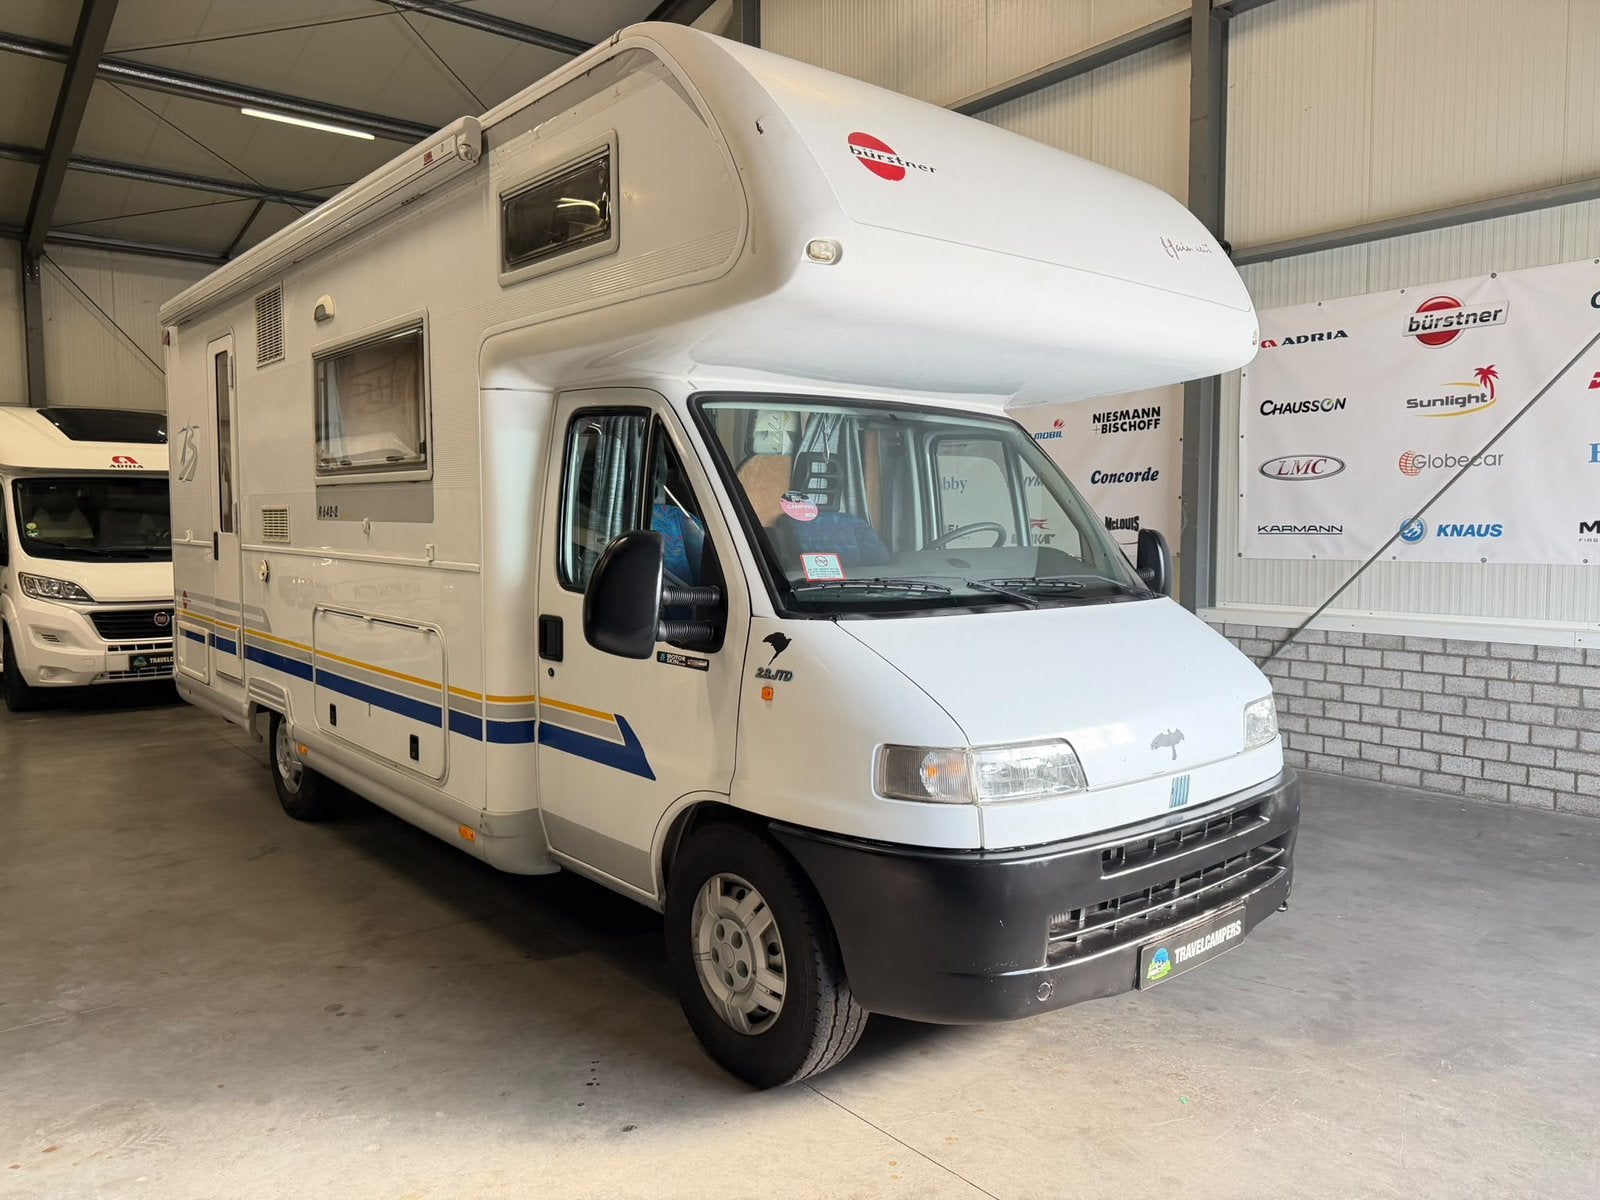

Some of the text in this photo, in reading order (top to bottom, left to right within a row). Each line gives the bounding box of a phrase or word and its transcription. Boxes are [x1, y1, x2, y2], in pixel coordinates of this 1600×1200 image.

[848, 144, 937, 174] bürstner
[1407, 308, 1503, 333] bürstner
[1281, 329, 1349, 347] ADRIA
[1259, 397, 1347, 416] CHAUSSON
[1406, 393, 1488, 409] Sunlight
[1092, 406, 1161, 424] NIESMANN
[1033, 430, 1064, 441] MOBIL
[1276, 458, 1328, 476] LMC
[1411, 453, 1504, 470] Globecar
[941, 475, 968, 494] bby
[1090, 467, 1160, 485] Concorde
[1257, 525, 1343, 533] KARMANN
[1436, 523, 1504, 538] KNAUS
[1174, 919, 1243, 965] TRAVELCAMPERS
